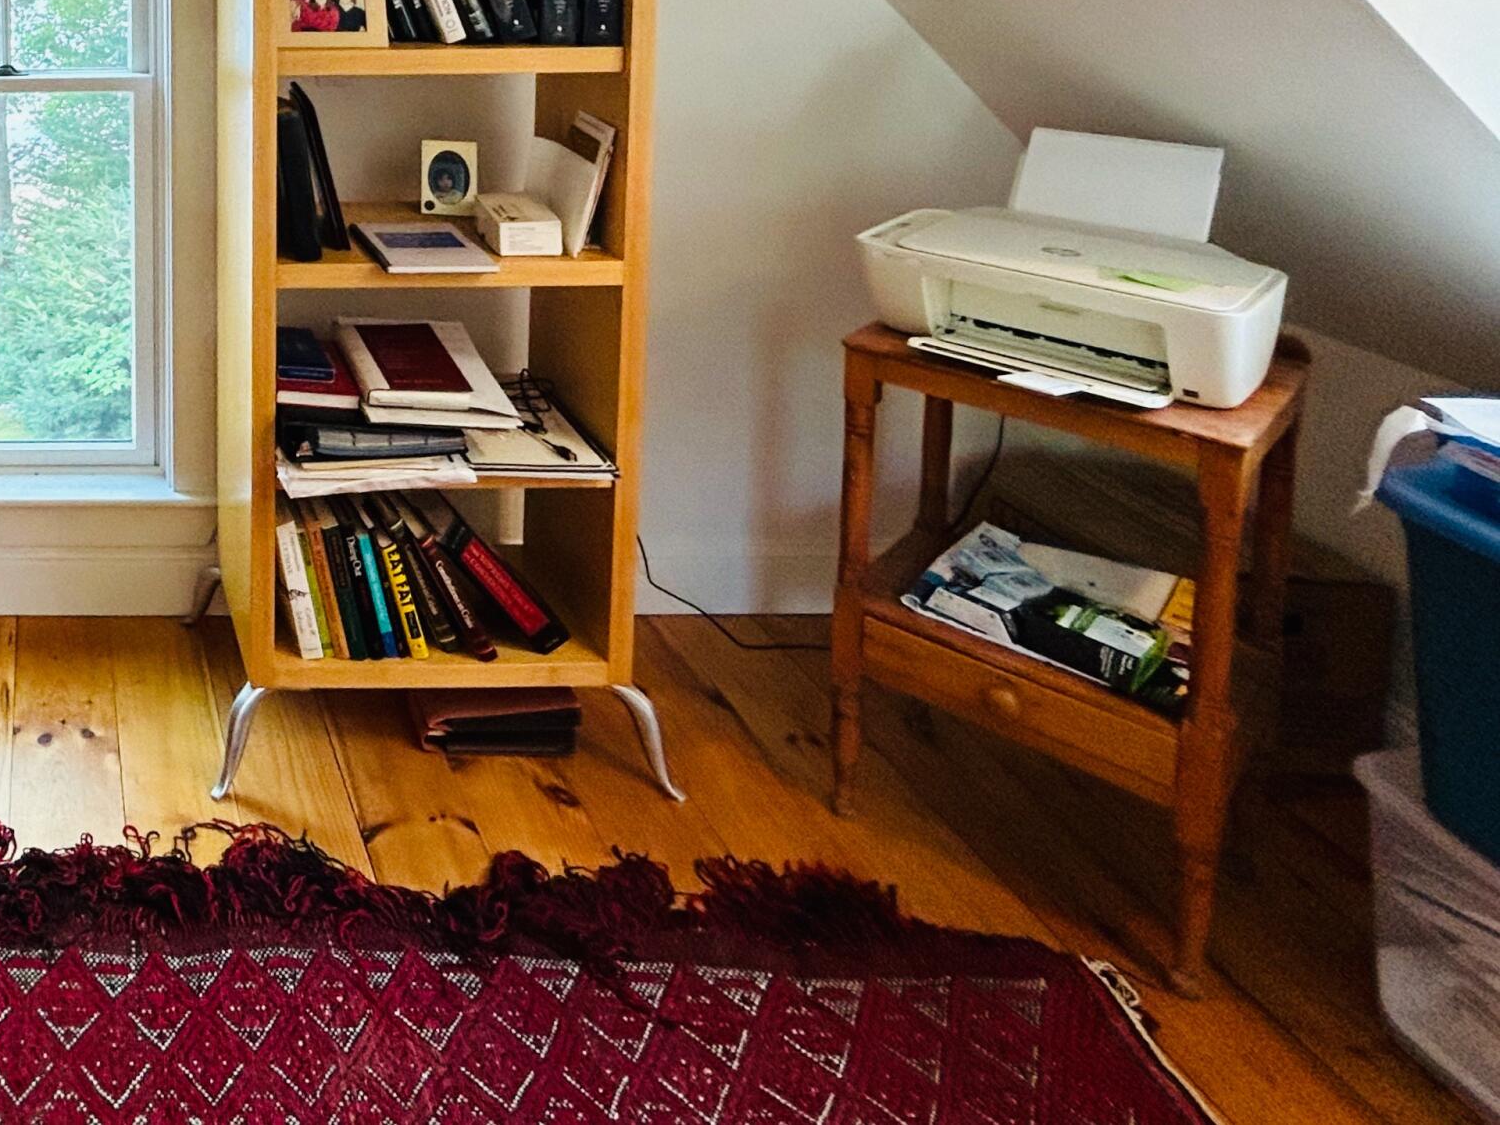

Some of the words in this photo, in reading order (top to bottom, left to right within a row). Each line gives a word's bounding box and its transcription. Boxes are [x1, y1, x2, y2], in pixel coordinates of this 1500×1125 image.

[352, 560, 363, 577] Out
[387, 549, 404, 578] EAT
[396, 582, 414, 608] FAT
[435, 560, 462, 605] Constitutions
[461, 608, 475, 629] Crisis
